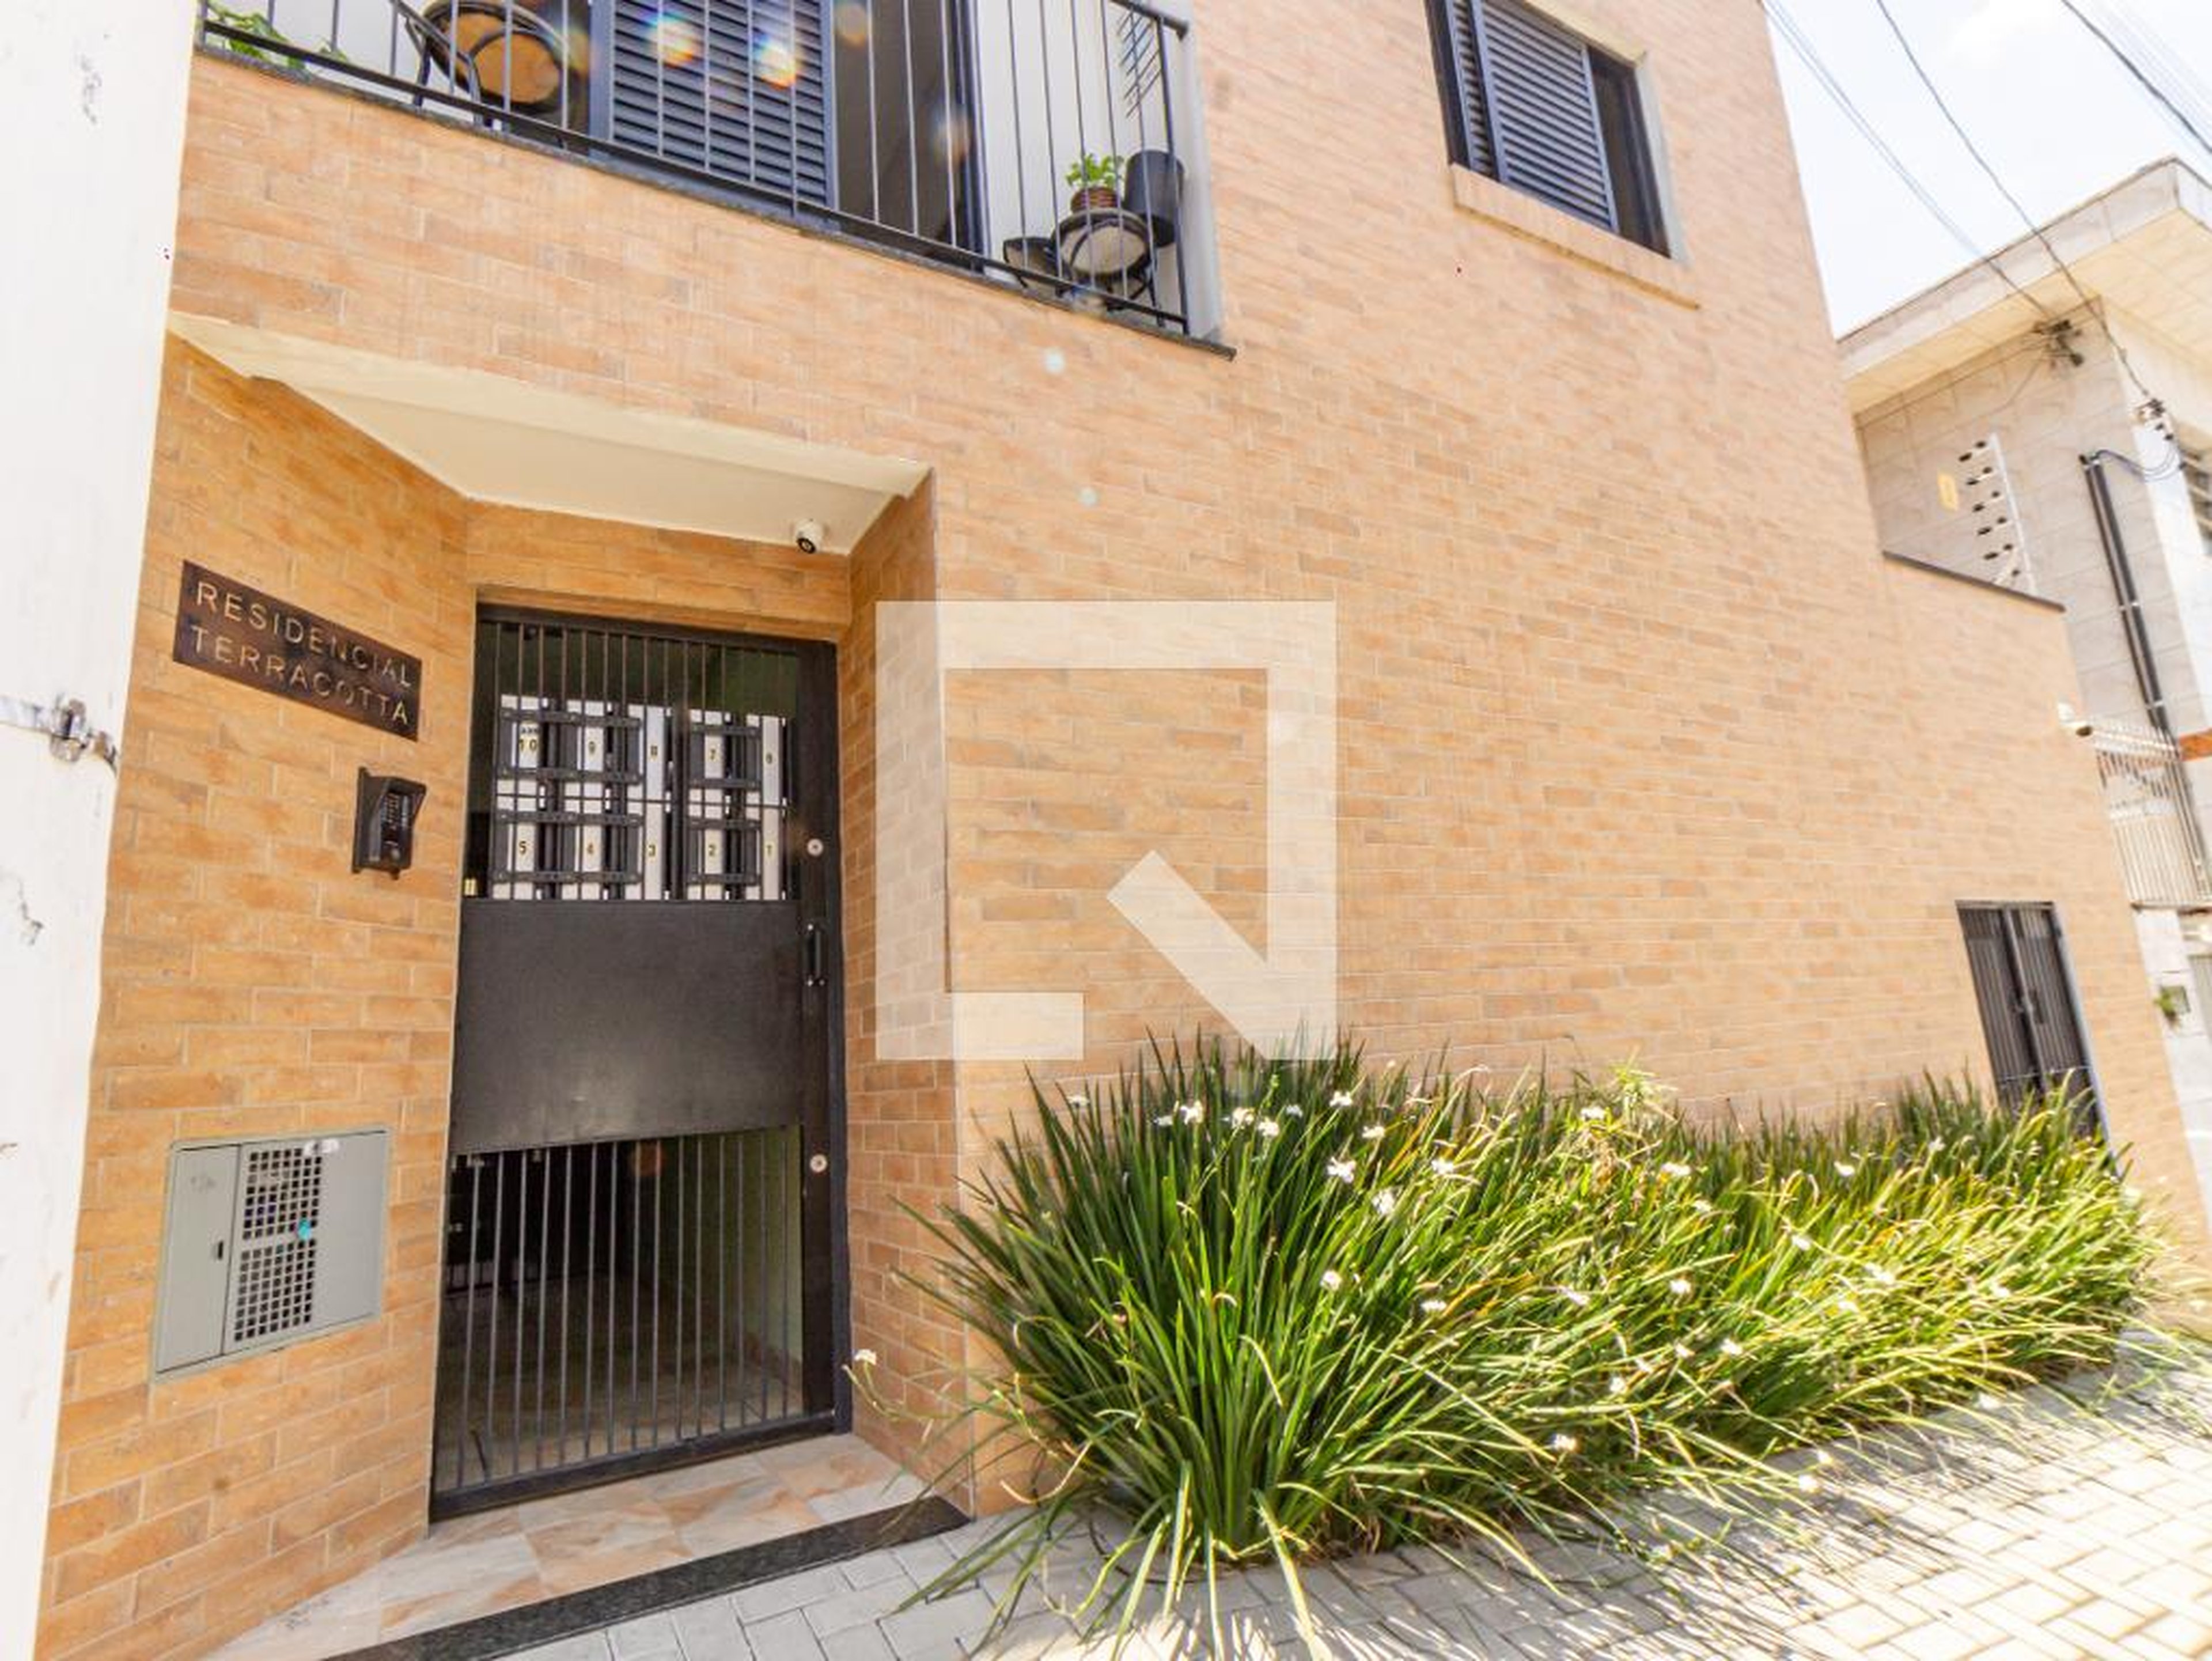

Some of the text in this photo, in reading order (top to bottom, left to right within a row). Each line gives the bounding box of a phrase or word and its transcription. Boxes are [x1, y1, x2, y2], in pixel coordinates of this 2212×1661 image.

[196, 580, 411, 687] RESIDENCIAL
[190, 625, 408, 725] TERRACOTTA
[519, 738, 537, 752] 10
[518, 841, 527, 855] 5
[648, 843, 656, 857] 3
[708, 843, 716, 857] 2
